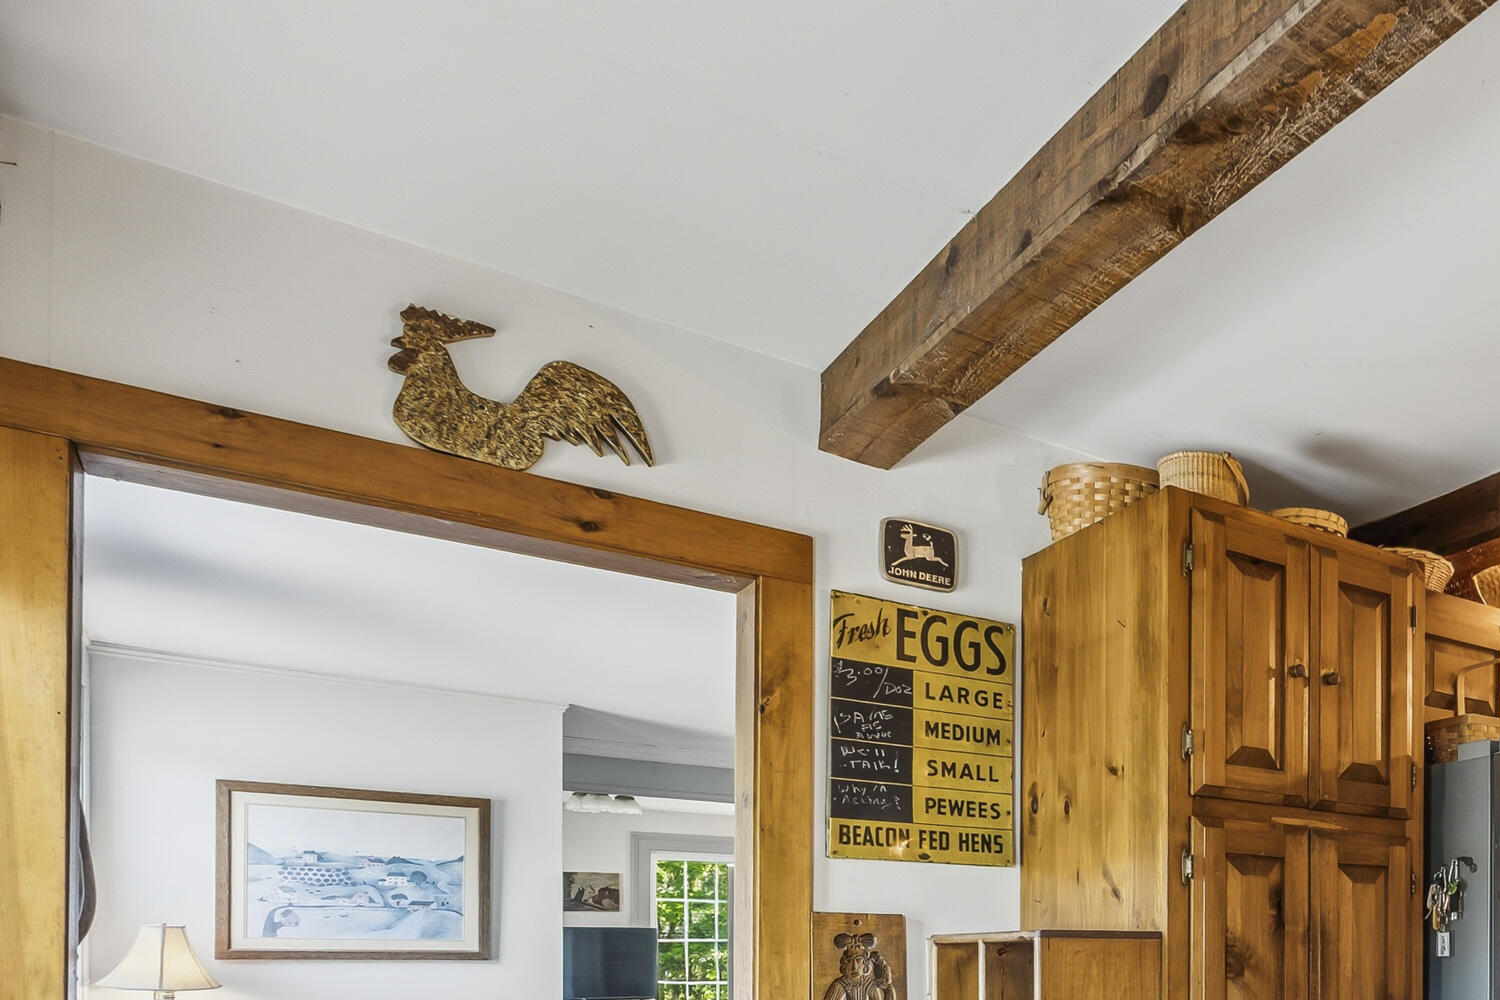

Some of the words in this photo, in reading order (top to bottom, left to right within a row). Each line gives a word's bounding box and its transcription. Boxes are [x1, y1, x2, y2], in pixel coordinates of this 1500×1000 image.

[888, 566, 917, 579] JOHN
[918, 571, 951, 586] DEERE
[833, 608, 891, 649] Fresh
[896, 608, 1007, 676] EGGS
[925, 682, 1003, 710] LARGE
[924, 720, 1001, 747] MEDIUM
[926, 759, 999, 782] SMALL
[924, 797, 1001, 820] PEWEES
[838, 824, 910, 848] BEACON
[918, 829, 951, 850] FED
[958, 832, 1004, 854] HENS
